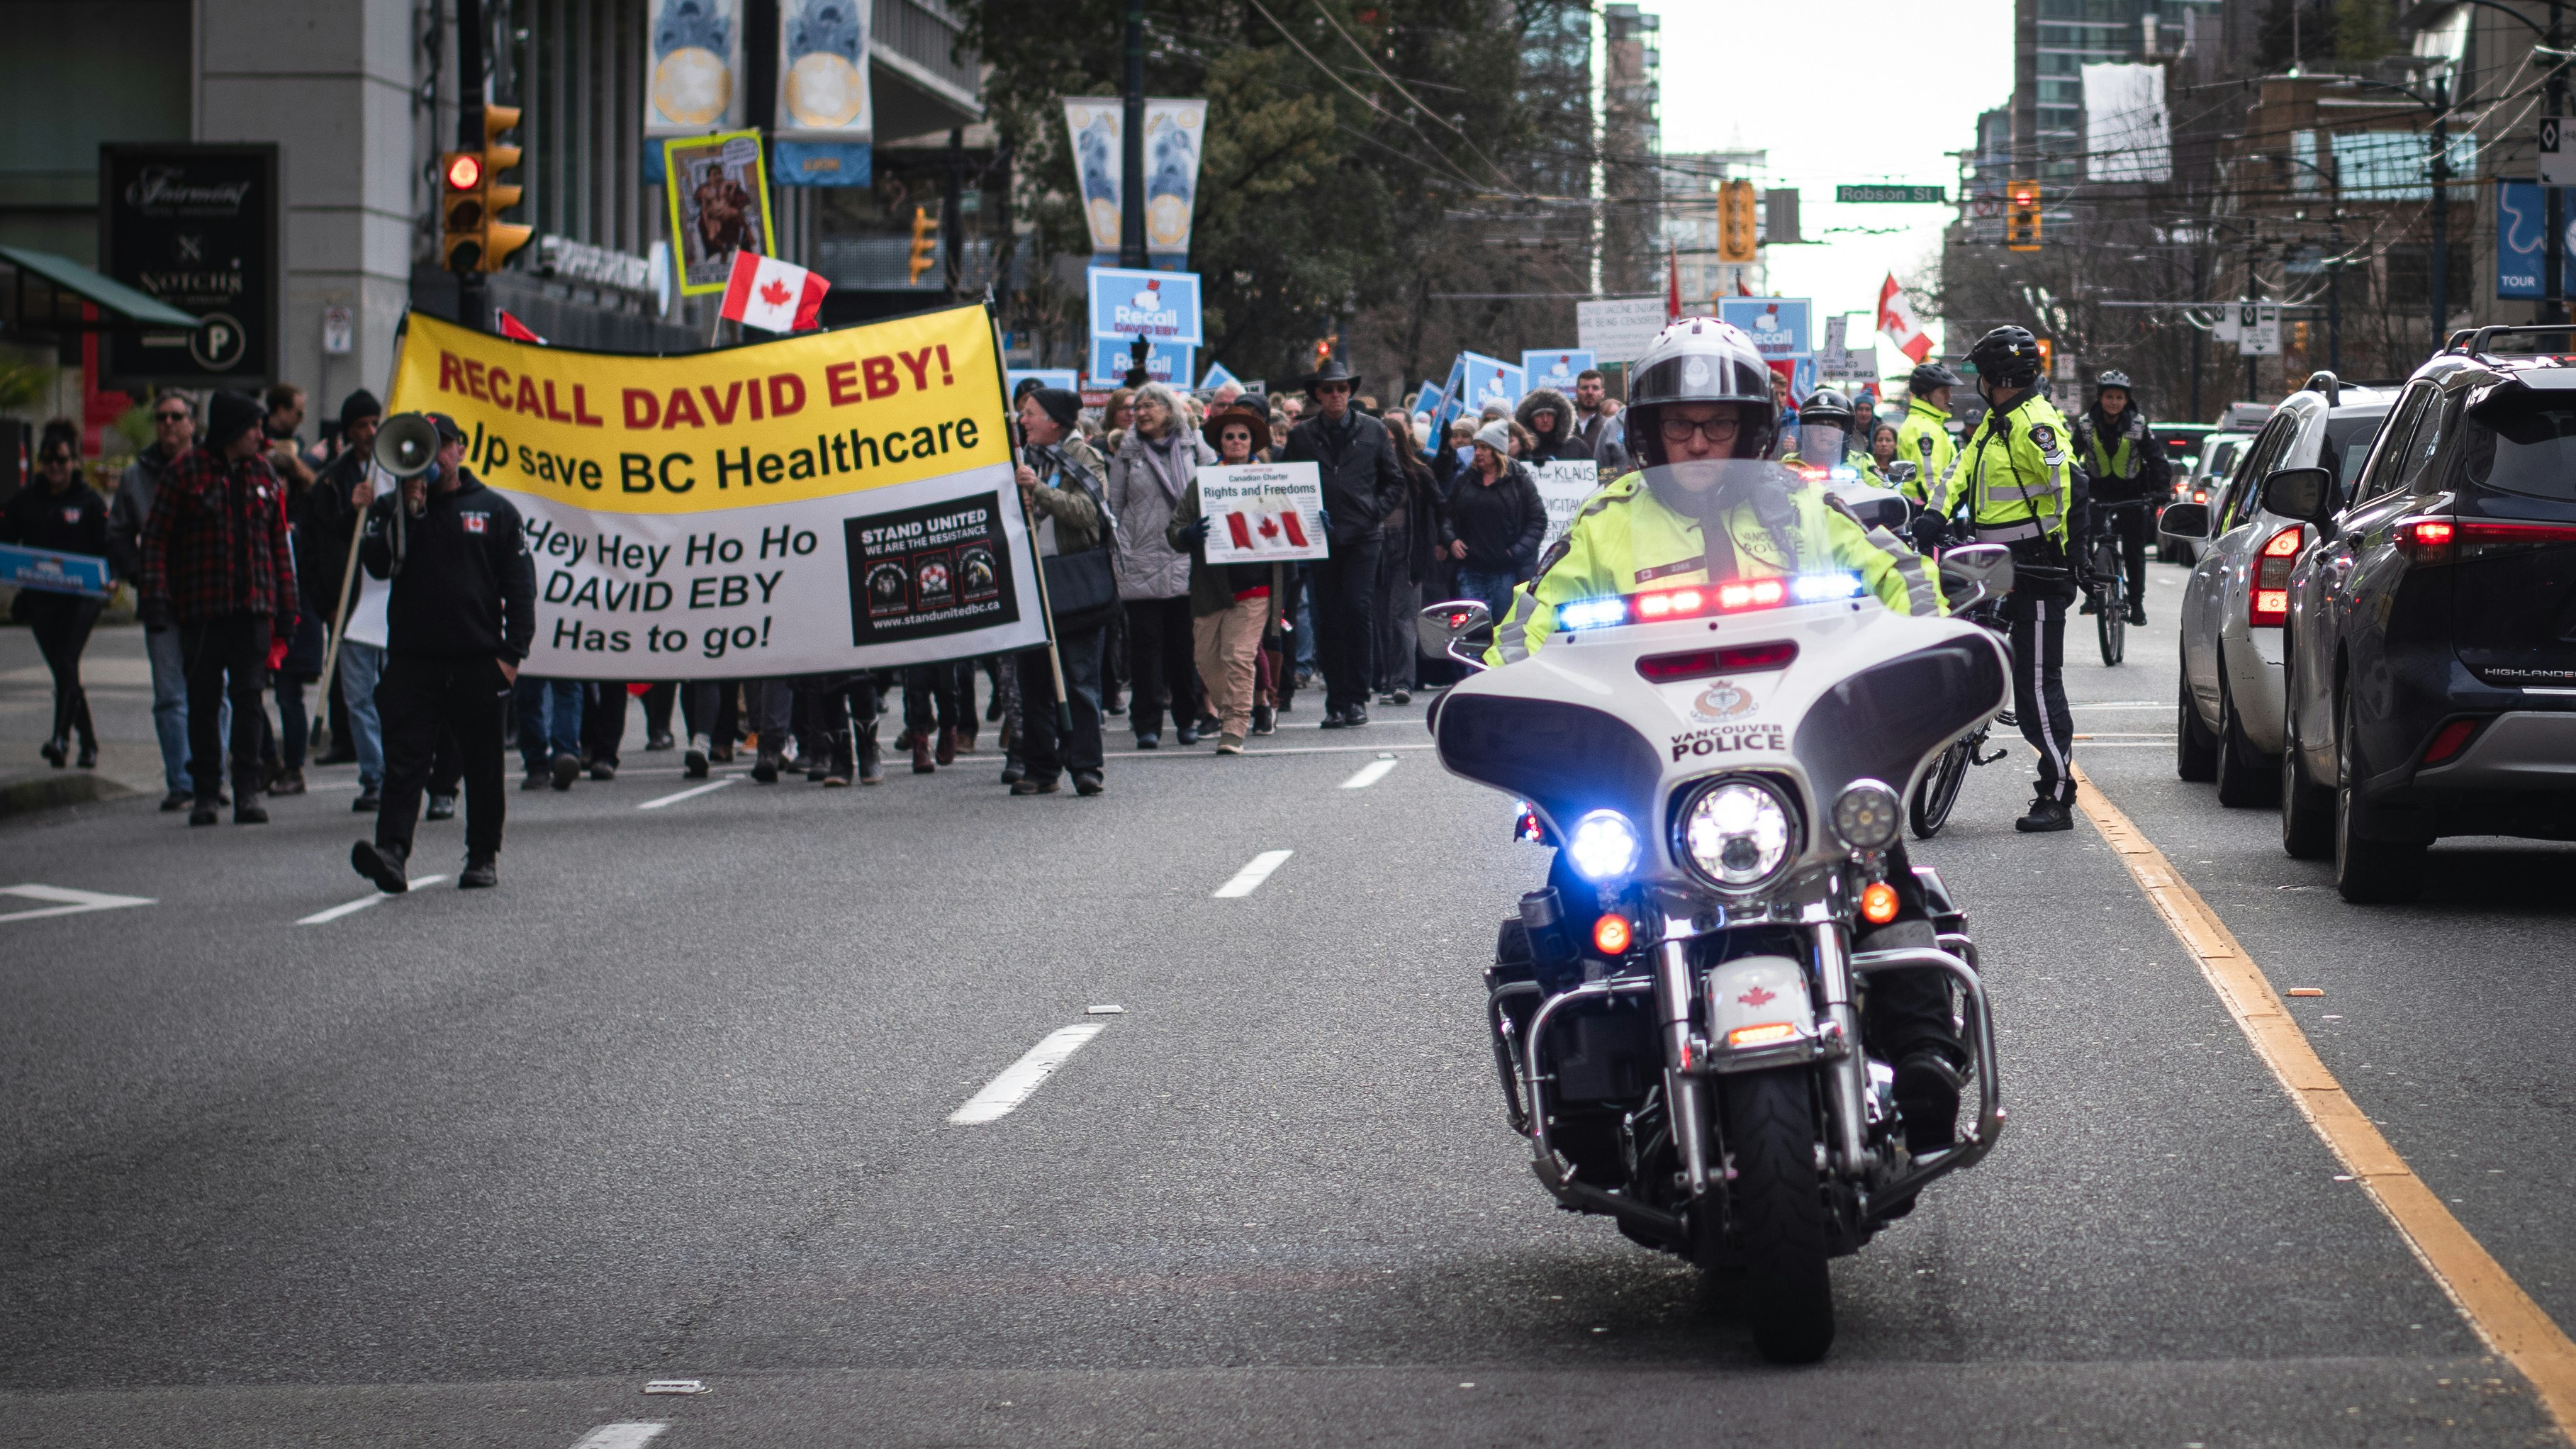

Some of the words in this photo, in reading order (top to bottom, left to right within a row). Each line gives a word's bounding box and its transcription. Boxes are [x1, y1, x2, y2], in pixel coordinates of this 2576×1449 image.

[1842, 187, 1906, 201] Robson
[1914, 187, 1932, 201] St
[2502, 276, 2536, 287] TOUR
[1114, 306, 1178, 327] Recall
[1620, 315, 1662, 325] CENSORED
[1114, 323, 1152, 335] DAVID
[1155, 325, 1180, 336] EBY
[438, 349, 604, 427] RECALL
[622, 372, 807, 431] DAVID
[826, 343, 956, 408] EBY!
[519, 445, 603, 492] save
[620, 452, 696, 495] BC
[716, 415, 981, 491] Healthcare
[1228, 474, 1260, 483] Canadian
[1263, 473, 1289, 481] Charter
[1555, 466, 1596, 481] KLAUS
[1204, 486, 1238, 499] Rights
[1241, 485, 1261, 496] and
[1265, 483, 1316, 495] Freedoms
[861, 521, 922, 545] STAND
[926, 508, 988, 532] UNITED
[525, 518, 588, 570] Hey
[598, 532, 671, 578] Hey
[685, 531, 744, 566] Ho
[760, 525, 819, 559] Ho
[865, 544, 883, 556] WE
[885, 540, 906, 553] ARE
[907, 535, 928, 549] THE
[929, 524, 987, 544] RESISTANCE
[543, 570, 674, 612] DAVID
[688, 570, 785, 609] EBY
[873, 600, 1000, 630] www.standunitedbc.ca
[551, 618, 632, 654] Has
[647, 623, 688, 654] to
[703, 617, 772, 659] go!
[2485, 668, 2576, 678] HIGHLANDE
[1671, 724, 1783, 744] VANCOUVER
[1671, 734, 1786, 763] POLICE
